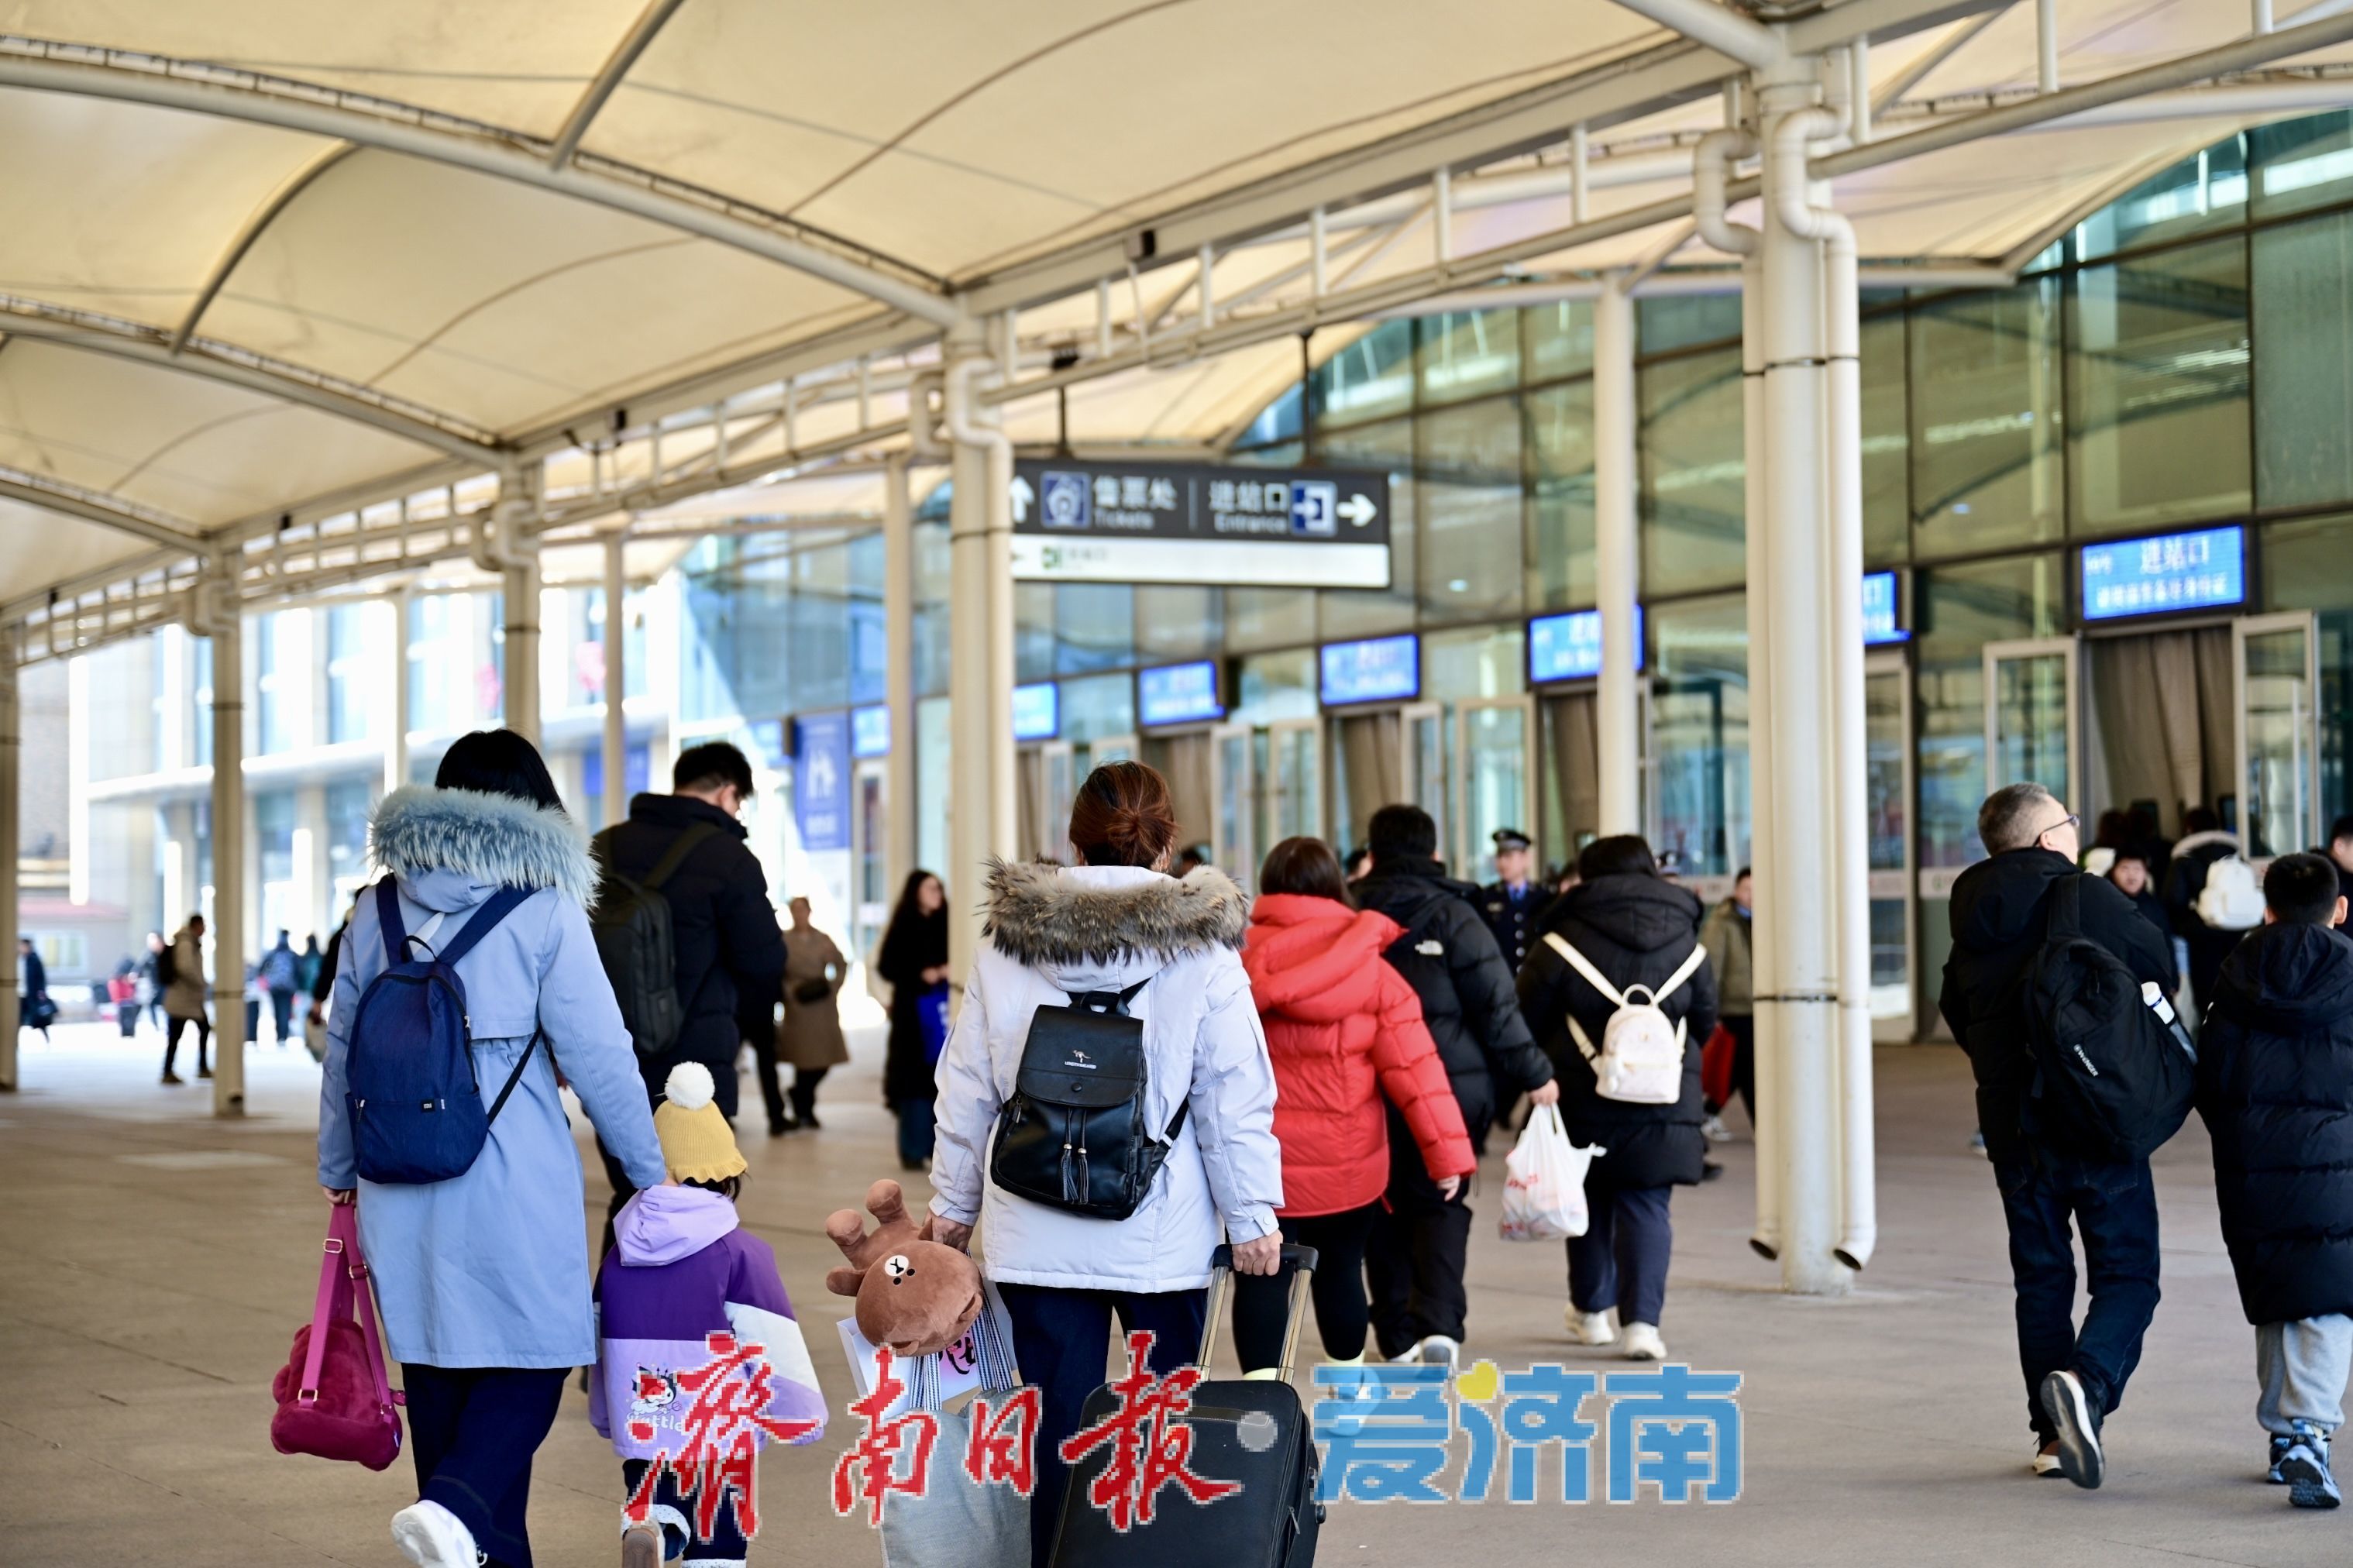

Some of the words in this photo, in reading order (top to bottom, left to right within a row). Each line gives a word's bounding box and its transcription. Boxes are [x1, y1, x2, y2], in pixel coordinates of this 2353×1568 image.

[1093, 475, 1177, 511] 售票处
[1209, 479, 1289, 513] 进站口
[1214, 512, 1288, 534] Entrance
